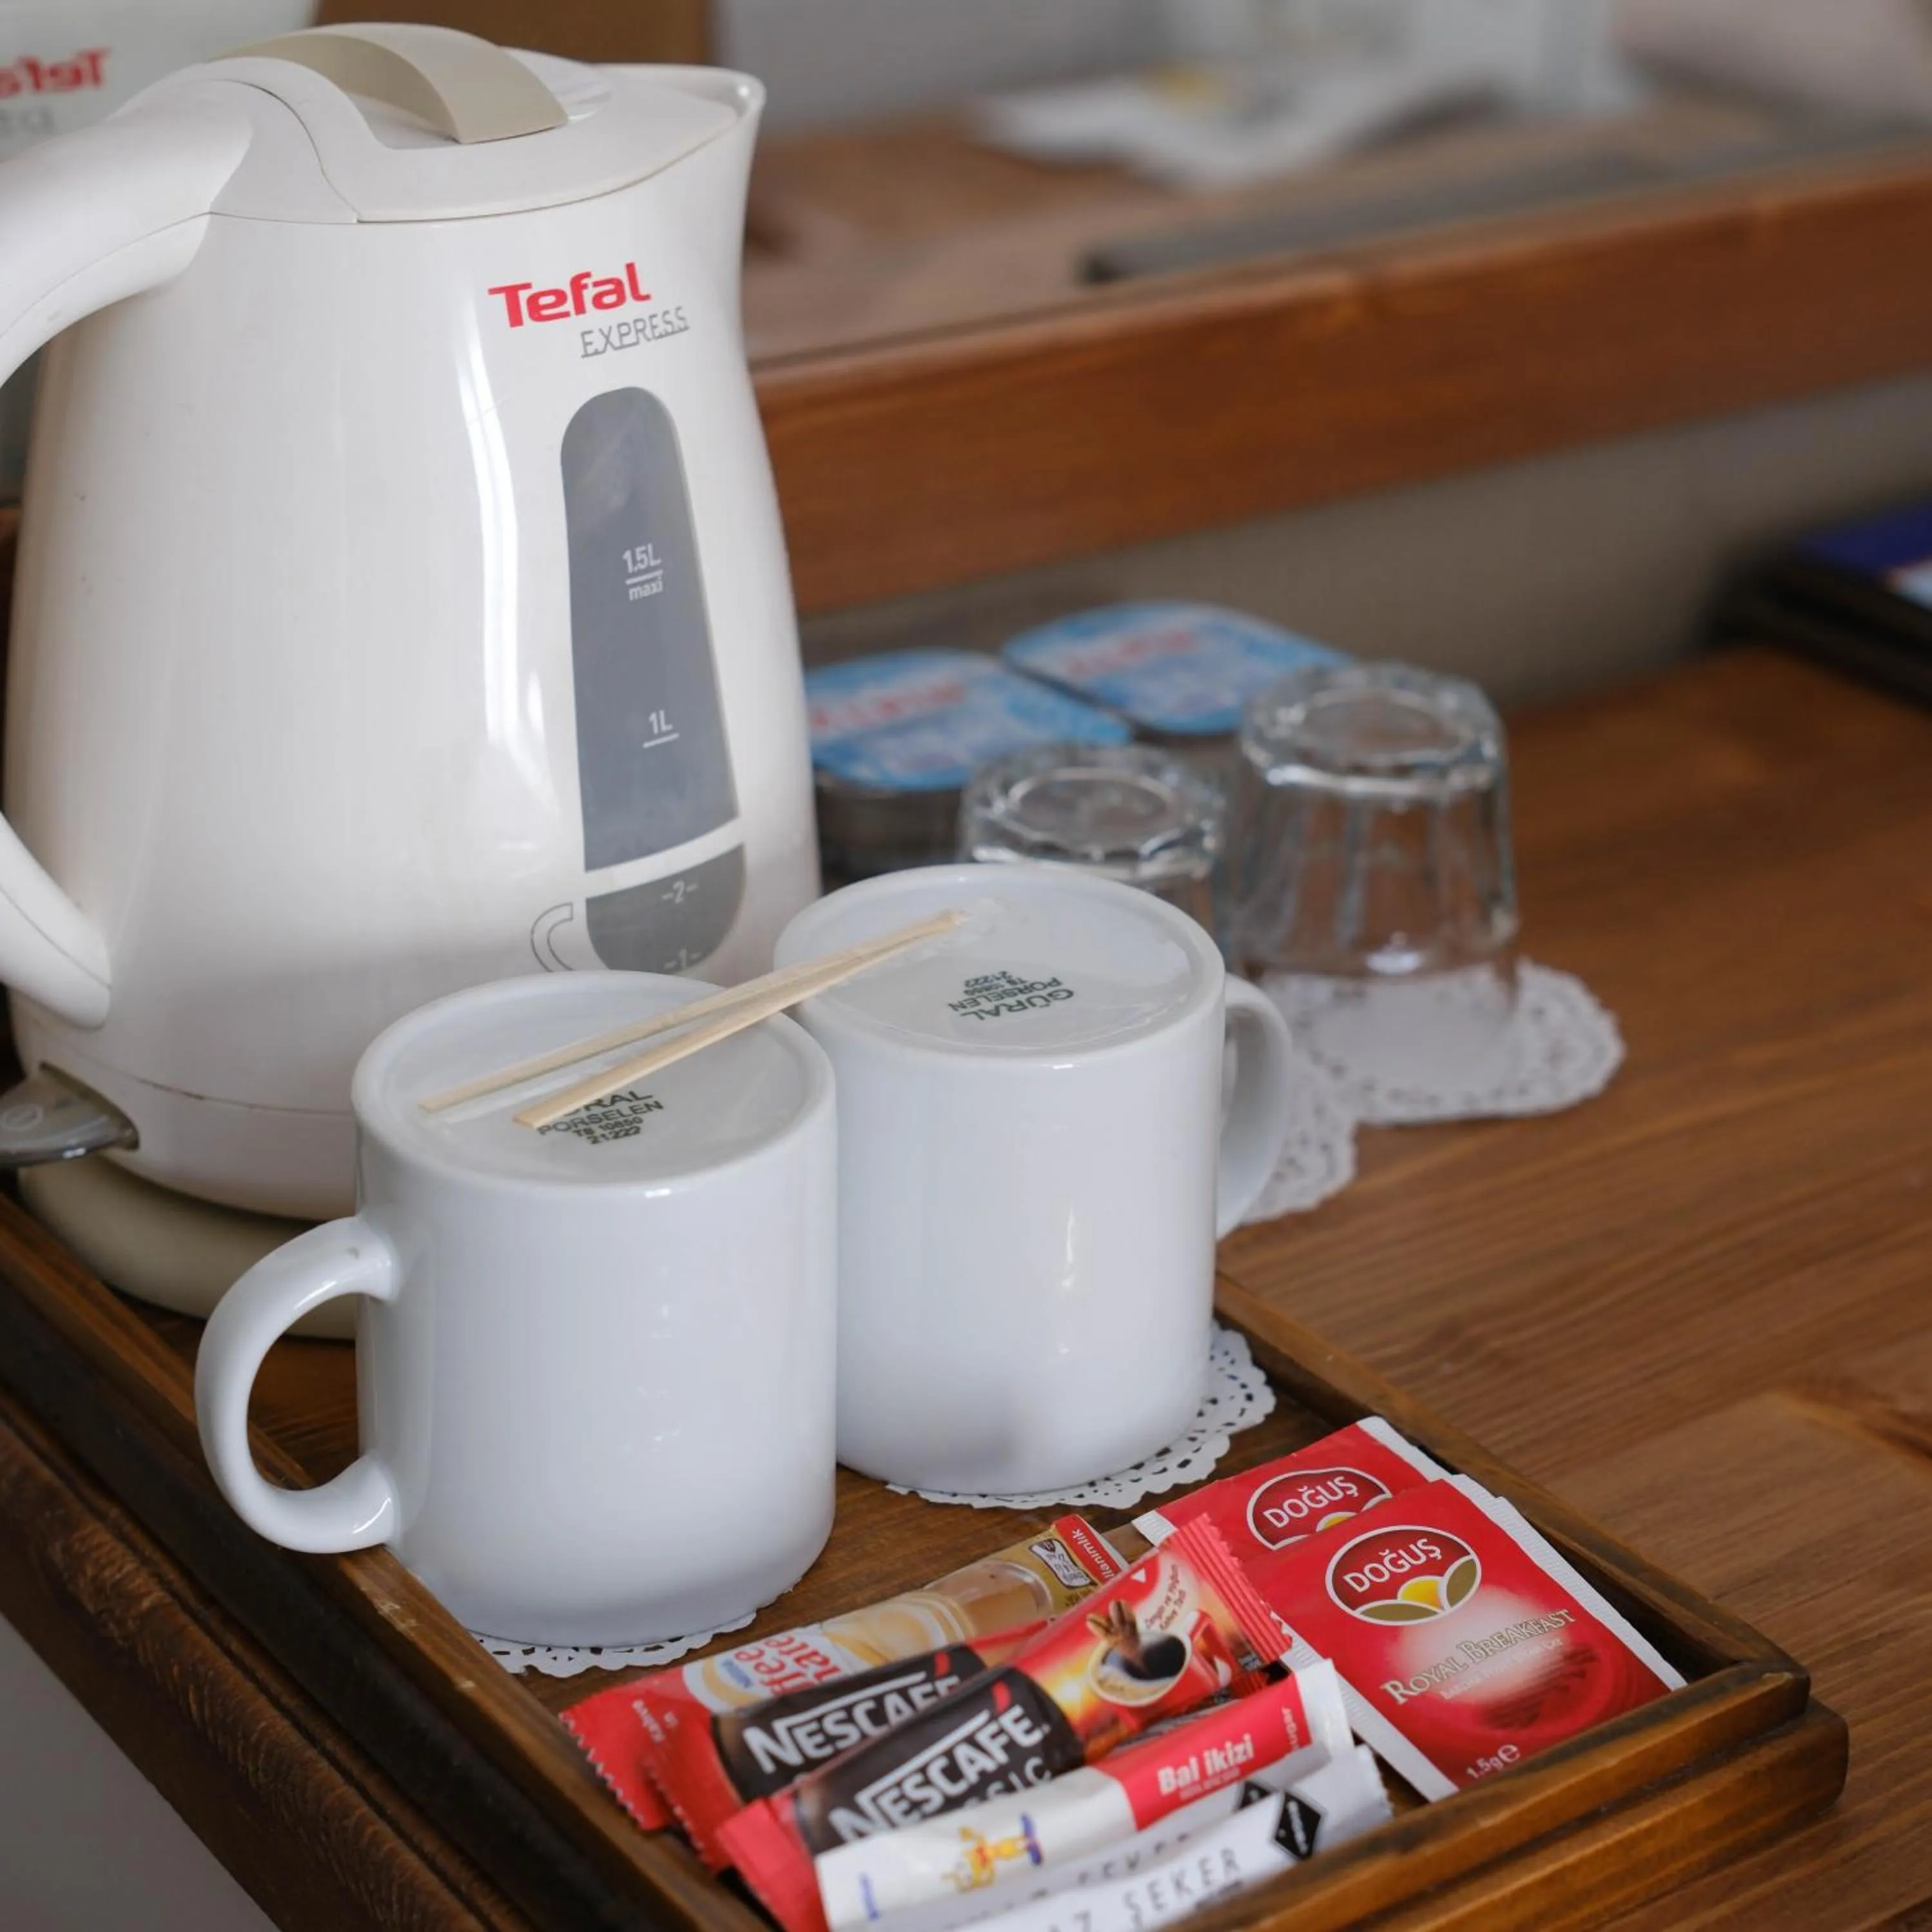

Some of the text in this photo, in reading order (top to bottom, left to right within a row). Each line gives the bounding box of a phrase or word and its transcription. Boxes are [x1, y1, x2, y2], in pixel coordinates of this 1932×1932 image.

[488, 261, 652, 328] Tefal
[580, 306, 690, 358] EXPRESS
[629, 576, 663, 601] maxi
[649, 710, 673, 734] 1L
[948, 977, 1063, 1012] PORSELEN
[960, 989, 1074, 1020] GÜRAL
[536, 1101, 664, 1135] PORSELEN
[563, 1090, 653, 1117] RAL
[1263, 1476, 1358, 1528] DOĞUŞ
[1343, 1538, 1442, 1593] DOĞUŞ
[1380, 1656, 1470, 1705] ROYAL
[1456, 1609, 1577, 1664] BREAKFAST
[1157, 1756, 1200, 1795] Bal
